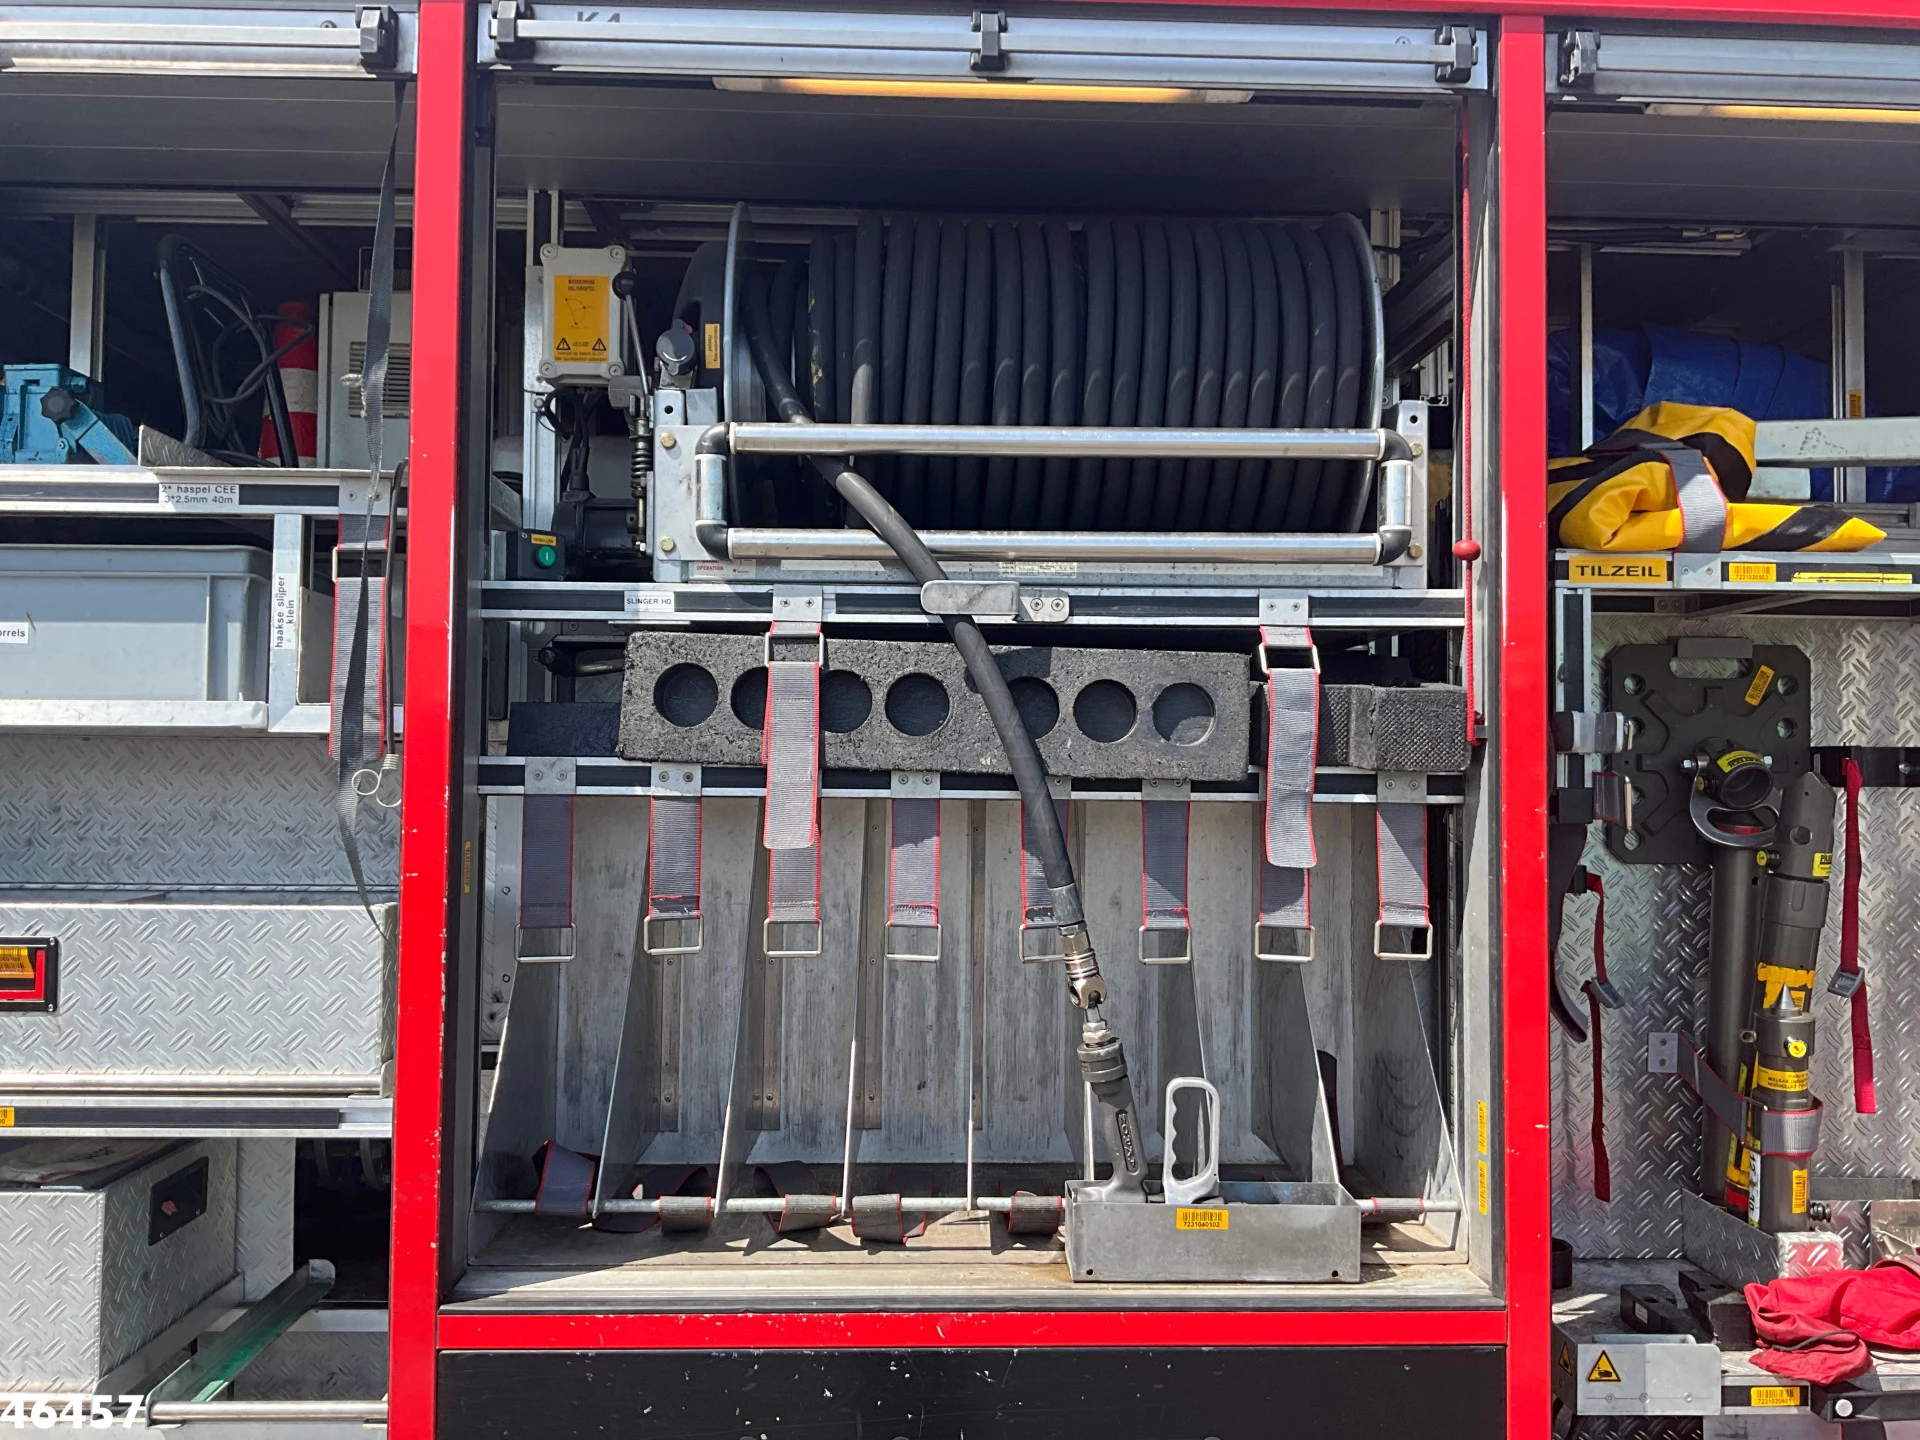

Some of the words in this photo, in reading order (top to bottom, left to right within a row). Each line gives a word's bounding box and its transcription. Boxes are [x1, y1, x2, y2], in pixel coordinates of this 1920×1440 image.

[176, 485, 211, 495] haspel
[214, 485, 237, 494] CEE
[212, 495, 233, 504] 40m
[1575, 565, 1661, 578] TILZEIL
[275, 576, 287, 607] slijper
[626, 597, 659, 605] SLINGER
[286, 600, 295, 624] klein
[275, 611, 284, 648] haakse
